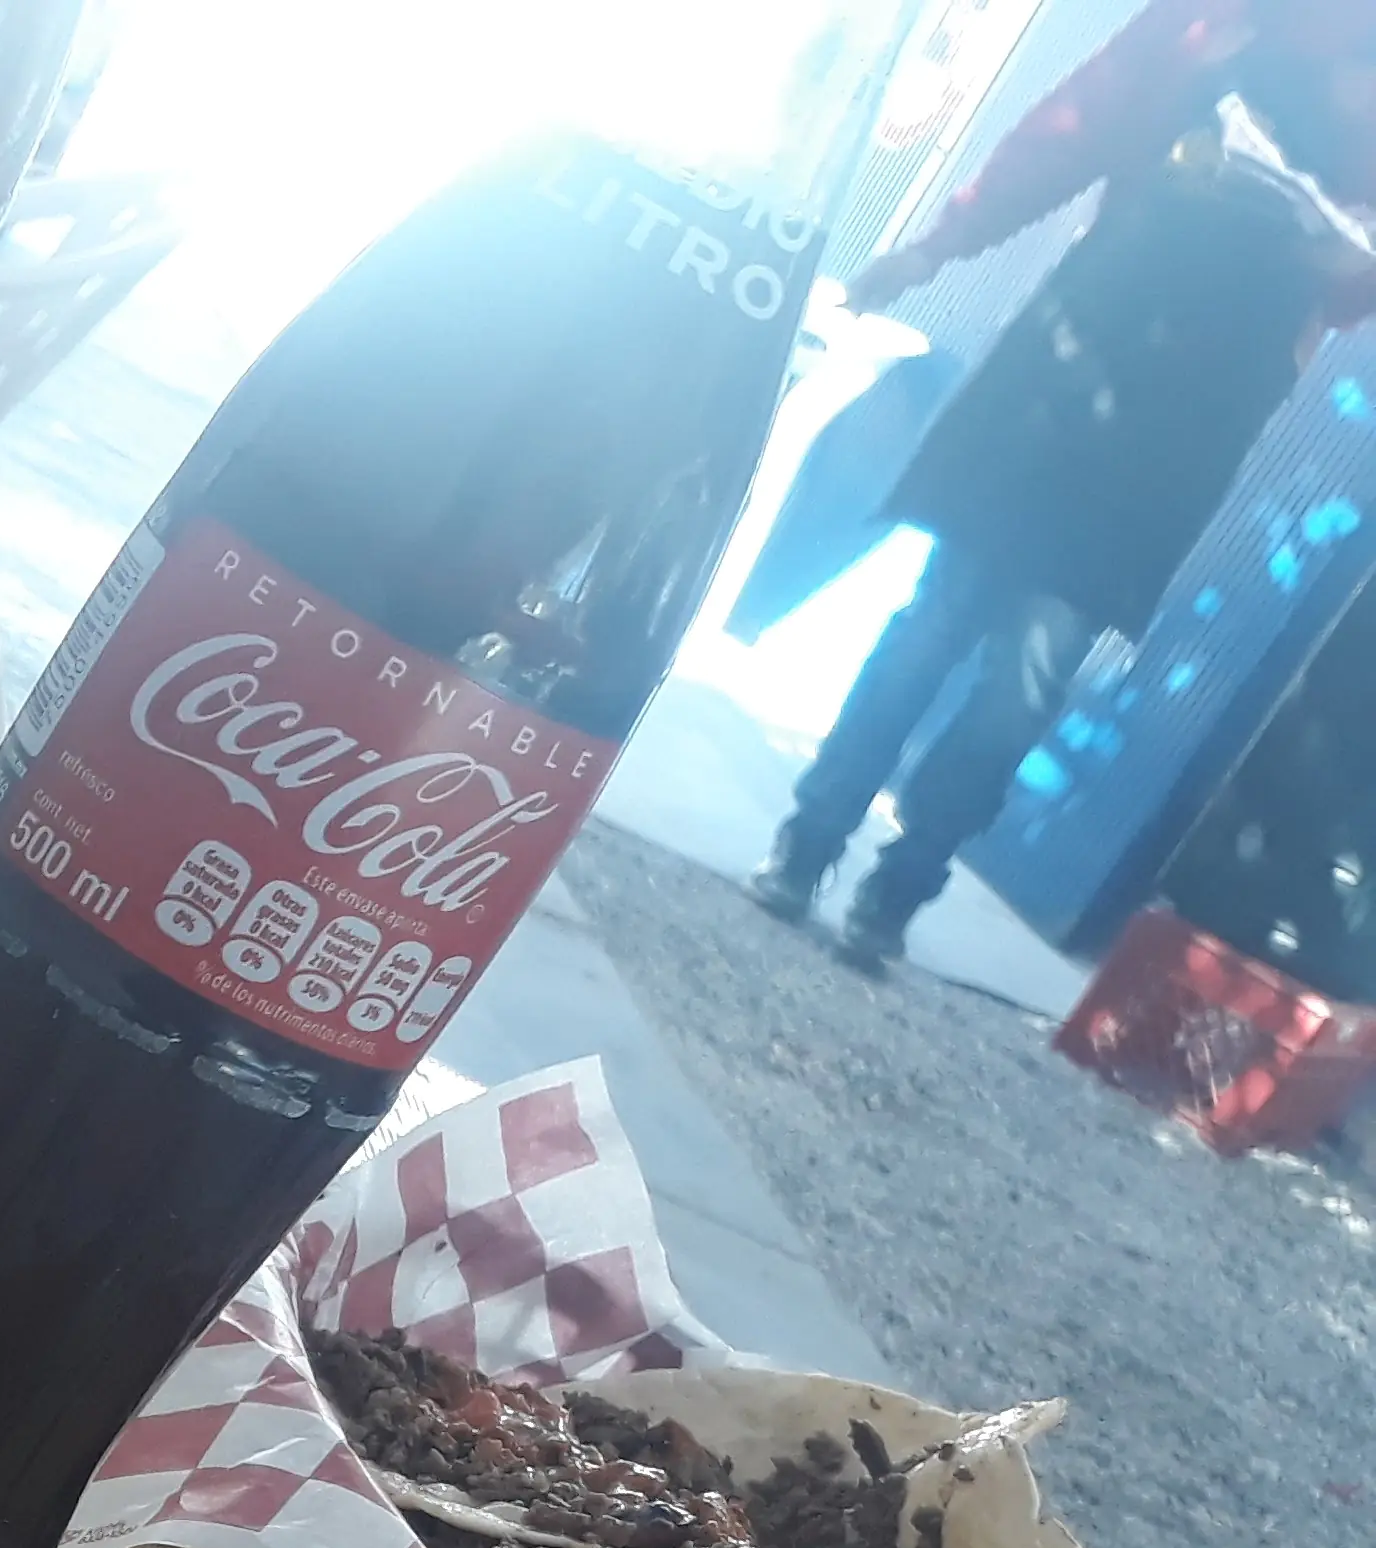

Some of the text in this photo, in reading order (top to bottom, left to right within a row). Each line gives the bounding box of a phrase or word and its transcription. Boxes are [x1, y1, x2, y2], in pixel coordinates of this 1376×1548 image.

[533, 174, 784, 320] LITRO
[214, 549, 594, 779] RETORNABLE
[59, 750, 115, 802] refresco
[129, 633, 559, 913] Coca-Cola
[10, 809, 130, 922] 500 ml
[182, 880, 196, 895] 0
[256, 904, 301, 934] grasas
[272, 888, 307, 917] Otras
[303, 865, 337, 895] Este
[336, 888, 386, 921] envase
[249, 919, 262, 935] 0
[232, 981, 255, 1006] los
